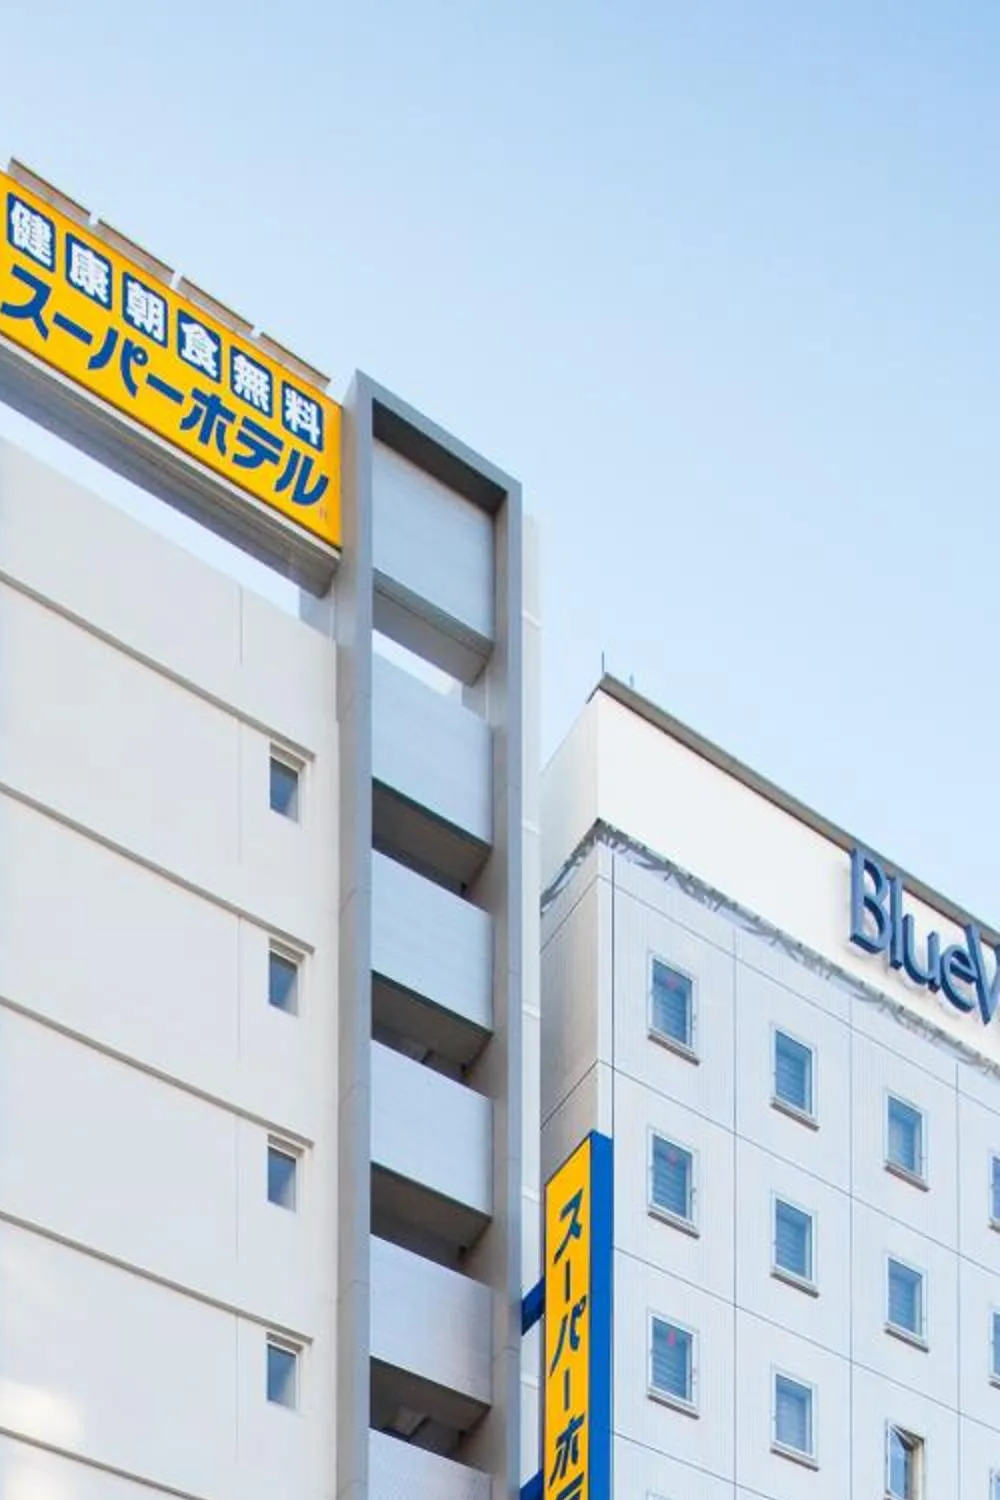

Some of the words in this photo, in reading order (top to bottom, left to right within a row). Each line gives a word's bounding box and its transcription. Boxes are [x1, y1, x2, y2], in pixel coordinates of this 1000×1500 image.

[0, 263, 329, 506] スーパーホテル
[8, 196, 322, 448] 健康朝食無料
